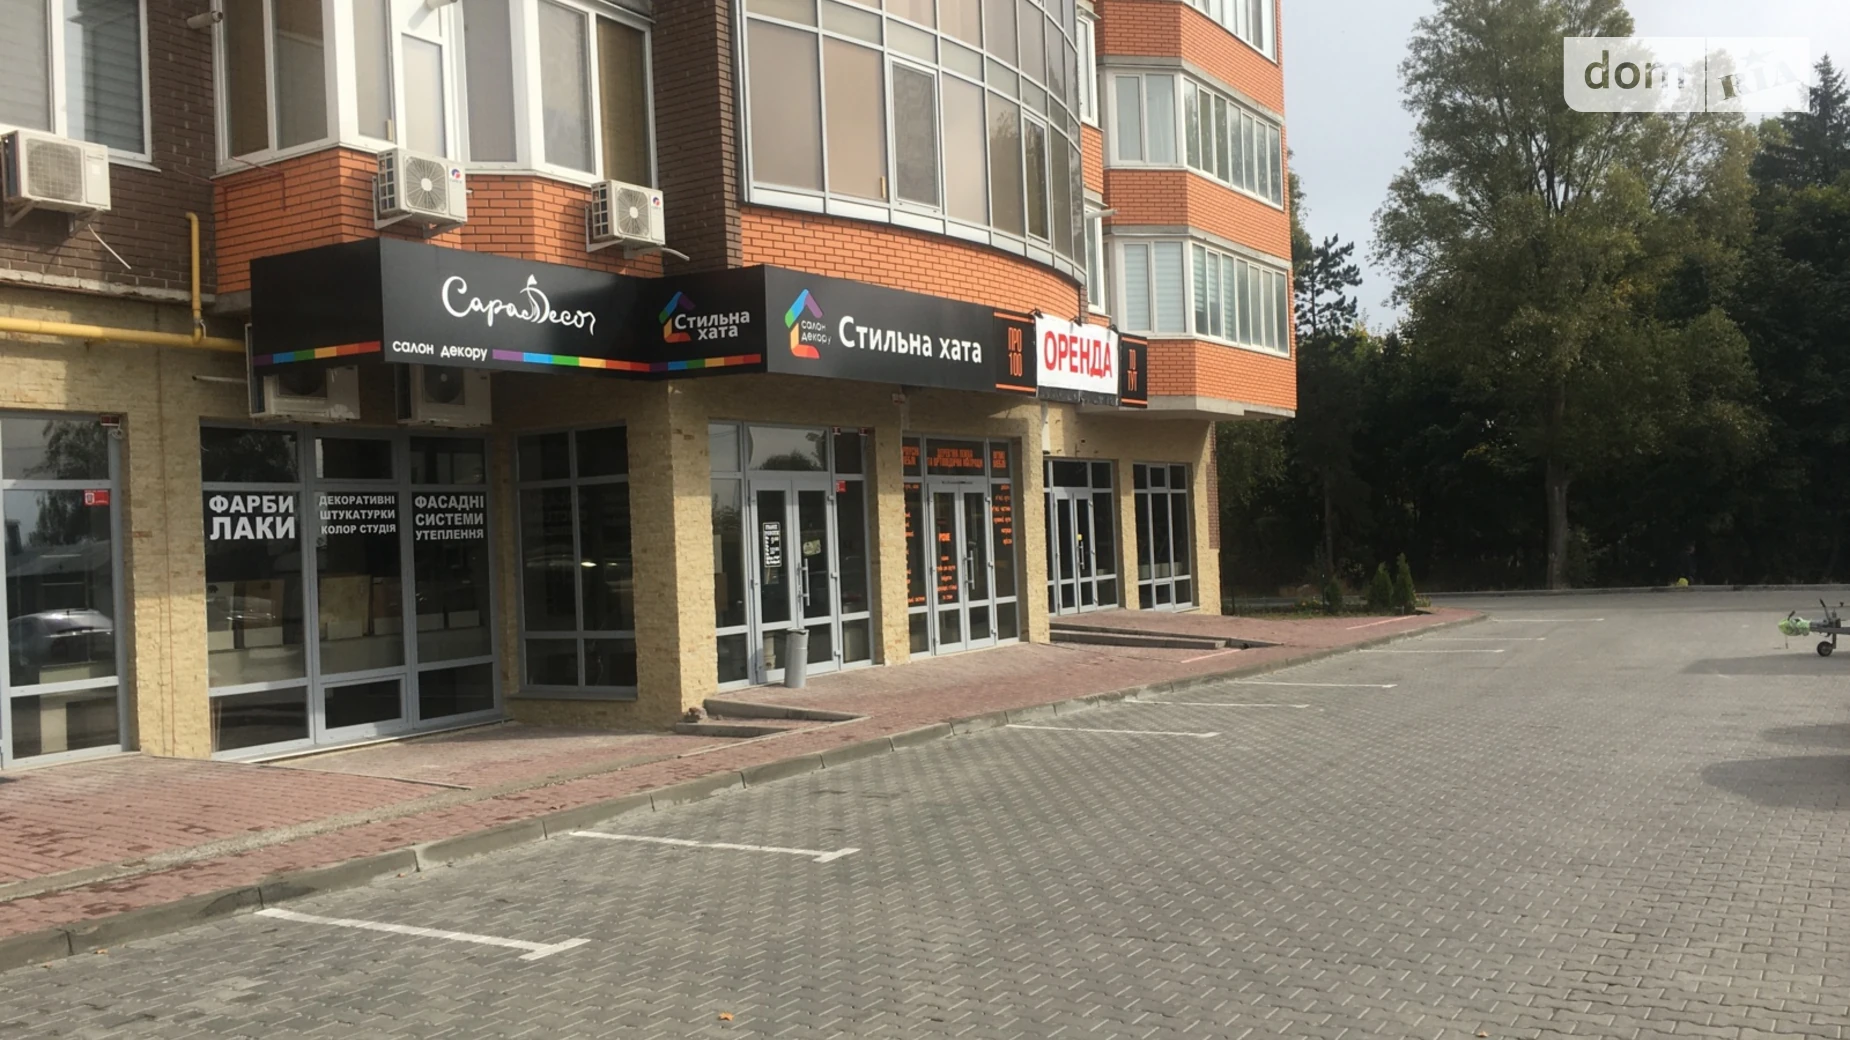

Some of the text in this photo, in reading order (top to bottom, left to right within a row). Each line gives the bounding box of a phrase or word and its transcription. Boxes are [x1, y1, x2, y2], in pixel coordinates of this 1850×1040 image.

[674, 310, 751, 330] Стильна
[800, 319, 827, 332] салон
[697, 324, 739, 341] хата
[800, 331, 832, 345] декору
[838, 315, 983, 364] Стильна хата
[1007, 326, 1023, 352] ПРО
[392, 340, 488, 361] салон декору
[1043, 330, 1113, 379] ОРЕНДА
[1008, 352, 1023, 378] 100
[208, 494, 295, 514] ФАРБИ
[318, 495, 396, 507] ДЕКОРАТИВНІ
[414, 495, 485, 511] ФАСАДНІ
[319, 509, 396, 521] ШТУКАТУРКИ
[414, 512, 485, 526] СИСТЕМИ
[209, 516, 296, 541] ЛАКИ
[320, 523, 397, 535] КОЛОР СТУДІЯ
[415, 528, 485, 541] УТЕПЛЕННЯ
